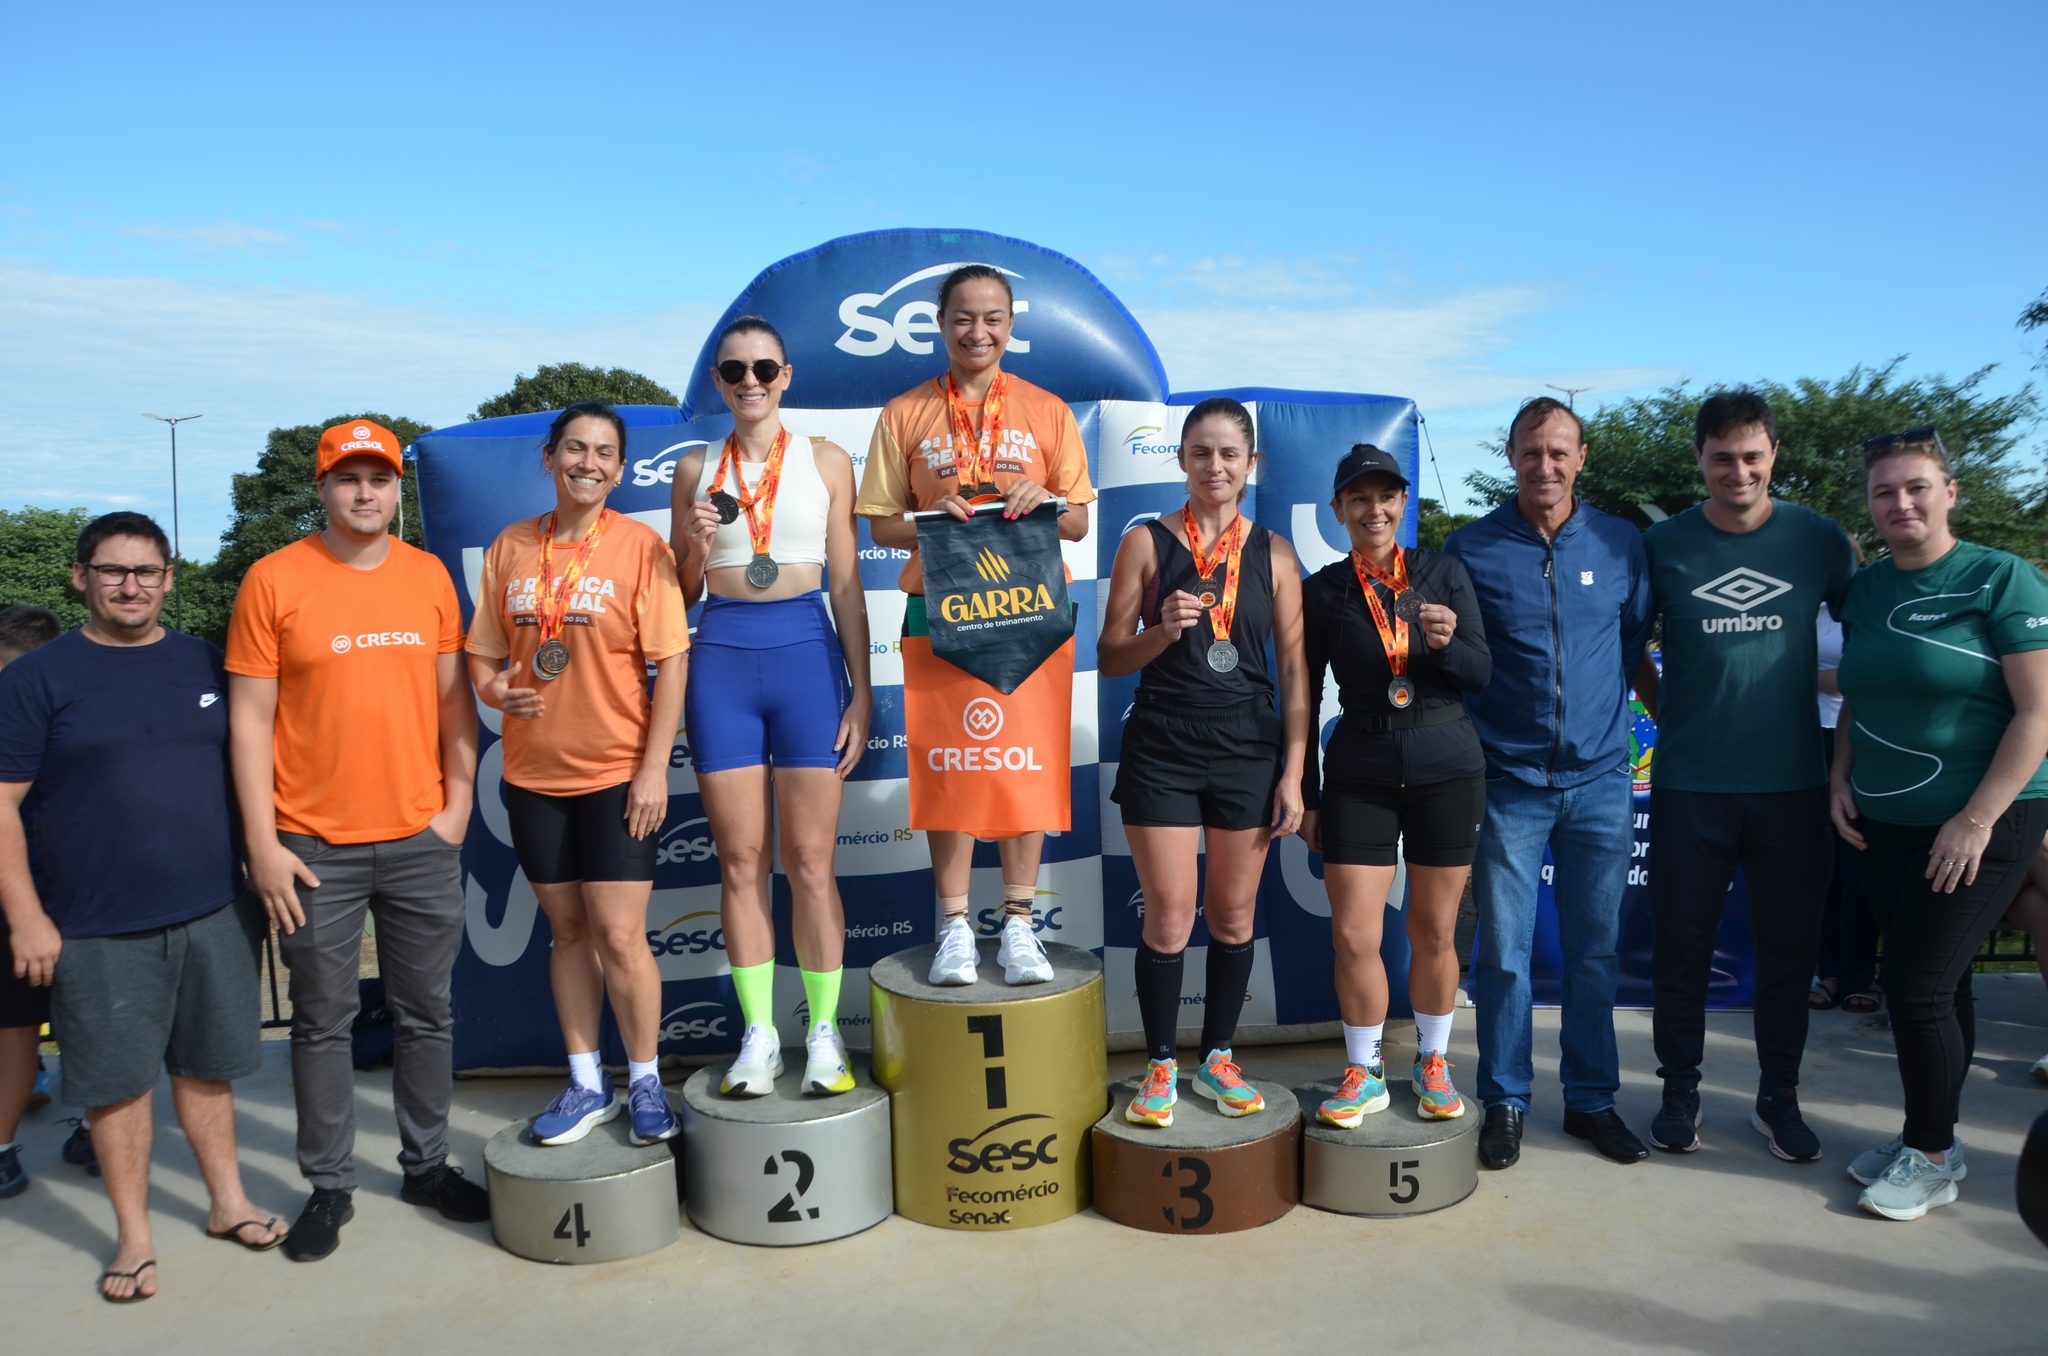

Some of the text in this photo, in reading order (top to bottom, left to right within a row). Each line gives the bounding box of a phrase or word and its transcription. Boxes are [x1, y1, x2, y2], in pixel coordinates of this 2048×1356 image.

[834, 290, 1030, 357] Sec
[340, 440, 385, 452] CRESOL
[1131, 443, 1180, 455] Fecom
[631, 458, 677, 487] Se
[941, 583, 1056, 623] GARRA
[957, 614, 1044, 632] centro de treinamento
[1702, 612, 1783, 634] umbro
[356, 631, 426, 648] CRESOL
[927, 746, 1043, 772] CRESOL
[836, 828, 913, 846] mércio RS
[844, 920, 913, 939] mércio RS
[966, 1013, 1008, 1110] 1
[763, 1149, 820, 1223] 2
[946, 1180, 1059, 1204] Fecomércio
[1161, 1156, 1215, 1230] 3
[1388, 1159, 1420, 1204] 5
[553, 1202, 591, 1247] 4
[948, 1208, 1012, 1225] Senac
